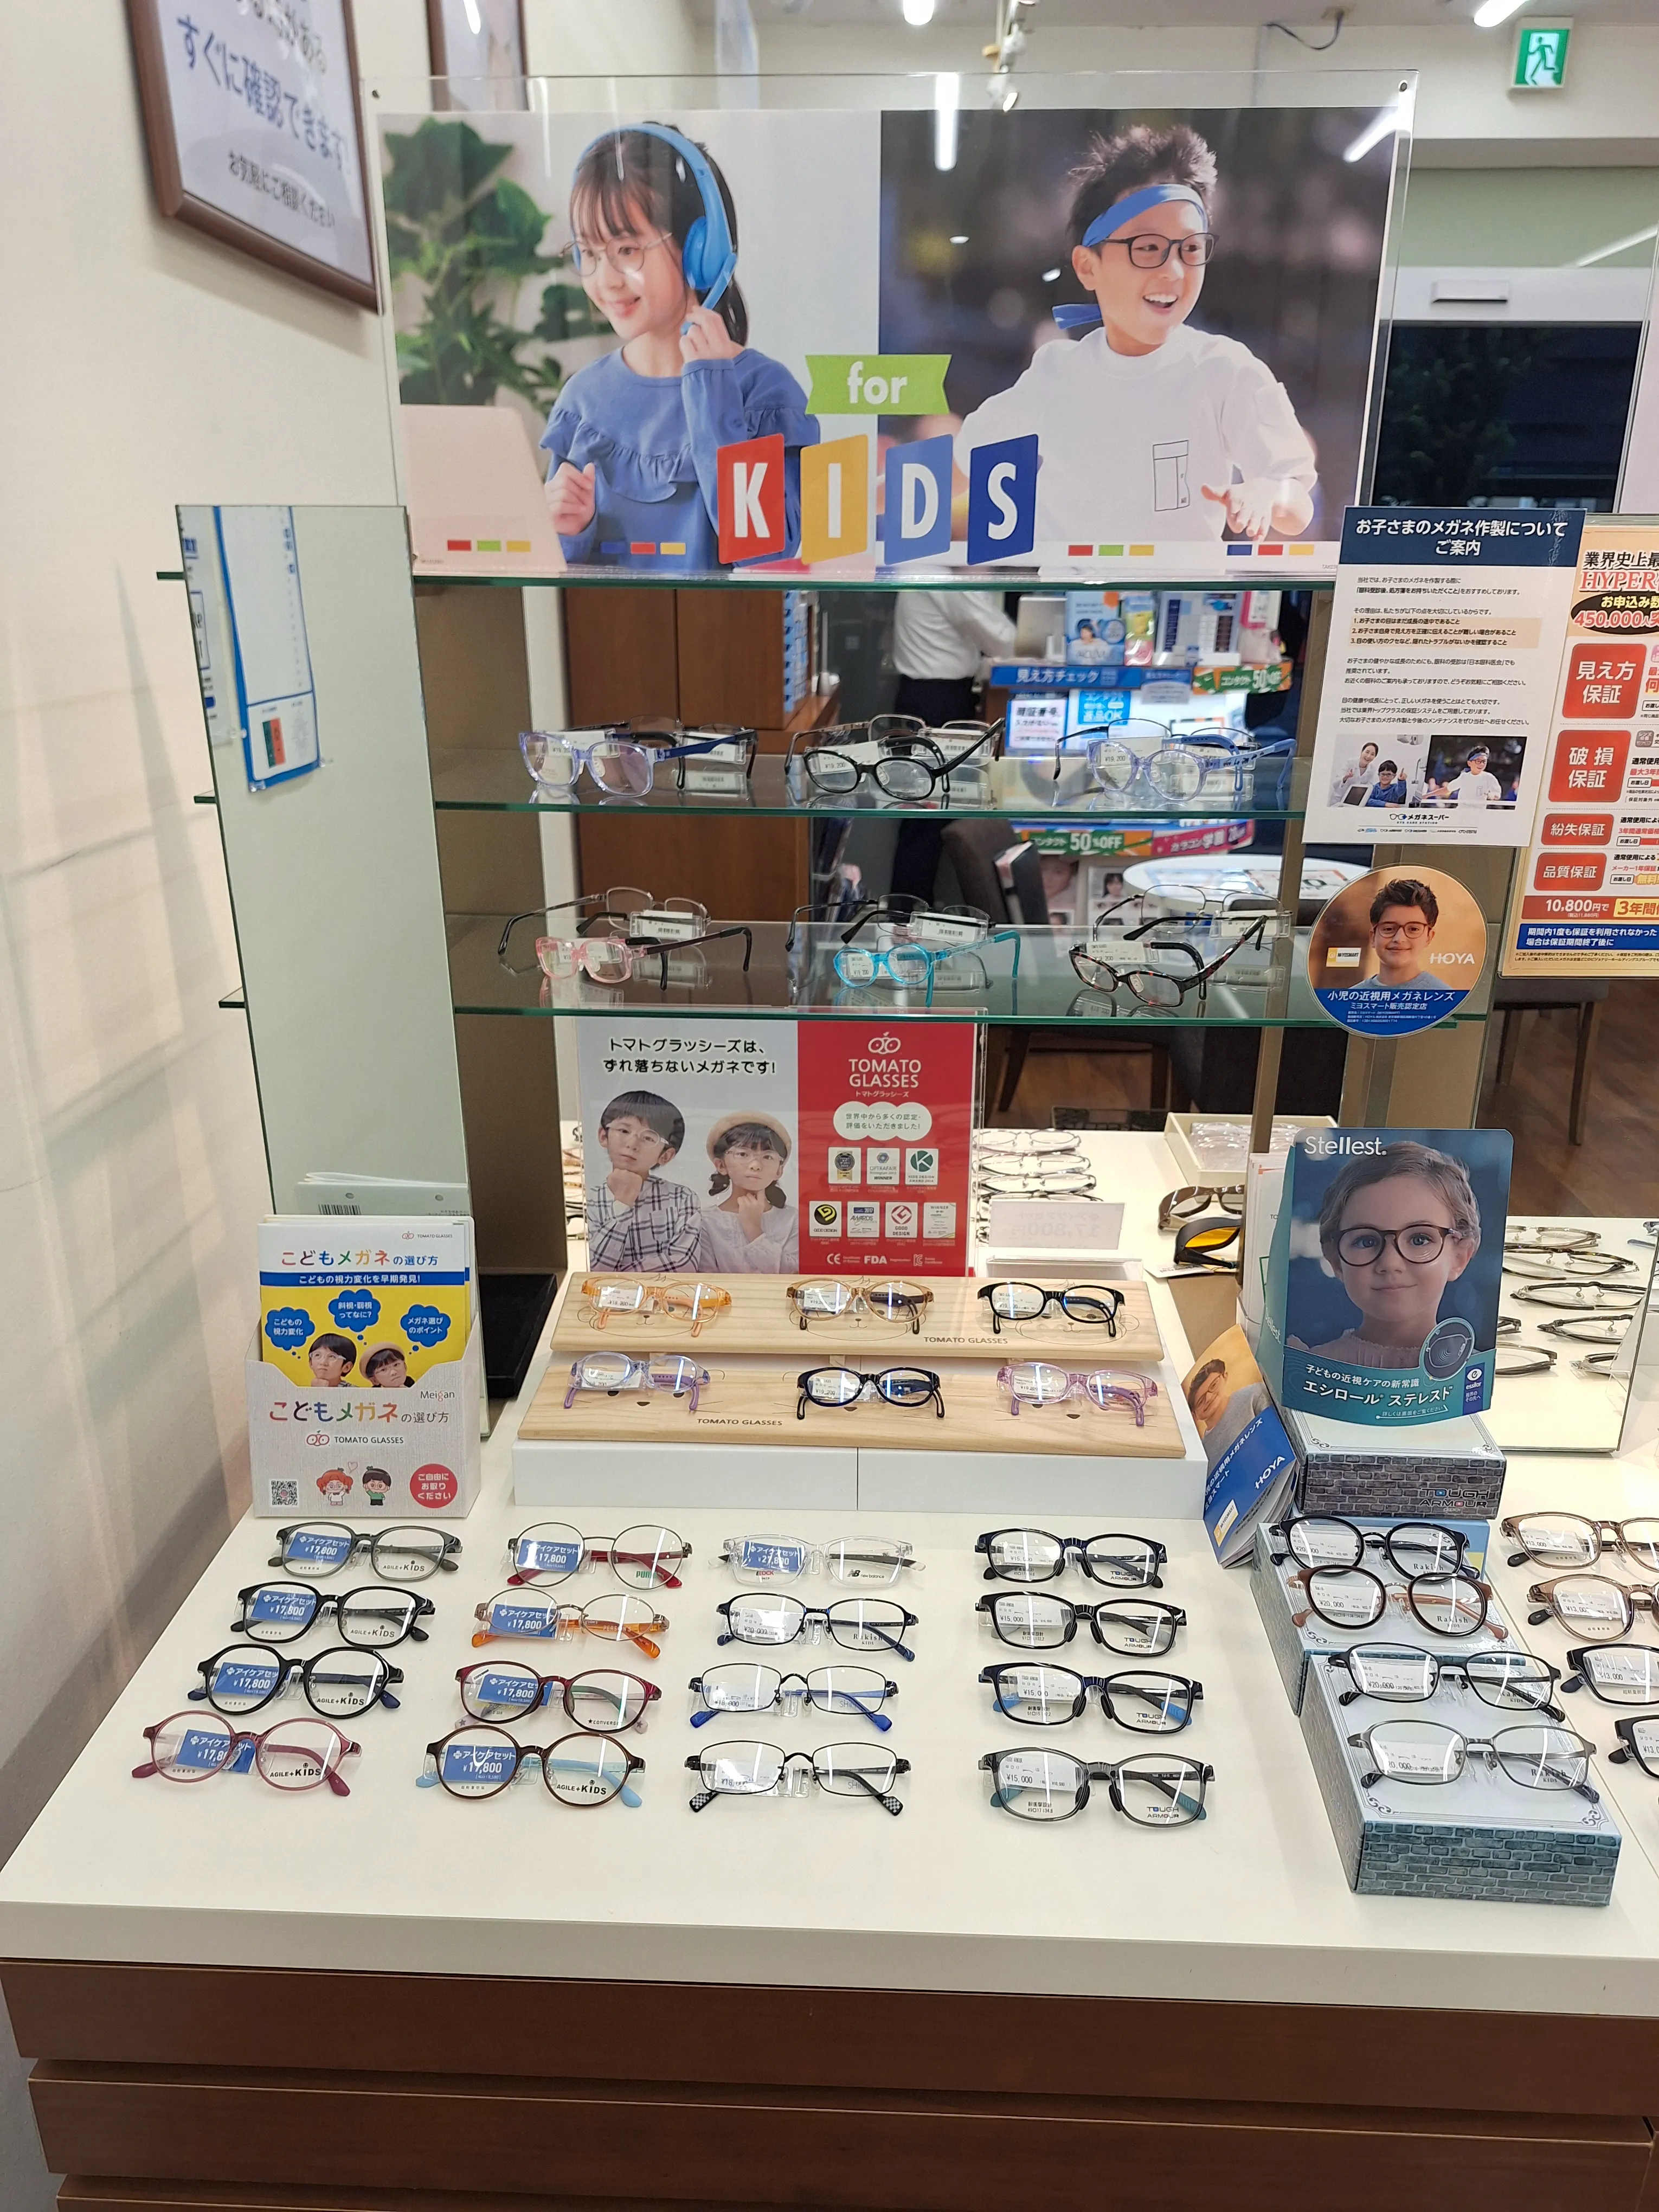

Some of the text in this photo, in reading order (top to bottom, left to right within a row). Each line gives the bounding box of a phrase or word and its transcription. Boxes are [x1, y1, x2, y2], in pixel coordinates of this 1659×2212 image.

[847, 361, 908, 404] for
[733, 462, 1018, 540] KIDS
[1356, 519, 1568, 537] お子さまのメガネ作製について
[1436, 541, 1481, 556] ご案内
[1577, 661, 1636, 681] 見え方
[1583, 684, 1622, 704] 保証
[1568, 770, 1607, 789] 保証
[1551, 823, 1605, 837] 紛失保証
[1543, 866, 1598, 879] 品質保証
[1546, 899, 1609, 912] 10,800円で
[1429, 953, 1475, 964] HOYA
[1327, 991, 1455, 1001] 小児の近視用メガネレンズ
[609, 1038, 764, 1054] トマトグラッシーズは、
[603, 1059, 776, 1075] ずれ落ちないメガネです!
[848, 1059, 921, 1073] TOMATO
[849, 1073, 918, 1088] GLASSES
[281, 1250, 439, 1266] こどもメガネの選び方
[864, 1255, 888, 1264] FDA
[299, 1275, 421, 1285] こどもの視力変化を早期発見!
[274, 1319, 302, 1327] こどもの
[407, 1317, 443, 1325] メガネ選び
[273, 1327, 304, 1336] 視力変化
[1306, 1364, 1419, 1388] 子どもの近視ケアの新常識
[420, 1390, 455, 1402] Meigan
[1303, 1380, 1451, 1406] エシロール ステレスト
[269, 1400, 450, 1424] こどもメガネの選び方
[417, 1472, 449, 1481] ご自由に
[1254, 1455, 1286, 1489] HOYA
[421, 1482, 446, 1490] お取り
[417, 1491, 451, 1500] ください
[1420, 1488, 1489, 1498] TOUGH
[306, 1537, 350, 1548] アイケアセット
[1525, 1539, 1547, 1548] ¥13,000
[305, 1545, 338, 1556] ¥17,800
[270, 1594, 316, 1606] アイケアセット
[269, 1605, 304, 1616] ¥17,800
[507, 1619, 542, 1630] ¥17,800
[234, 1666, 279, 1679] アイケアセッ
[233, 1677, 270, 1689] ¥17,800
[497, 1687, 535, 1699] ¥17,800
[1006, 1773, 1033, 1784] ¥15,000
